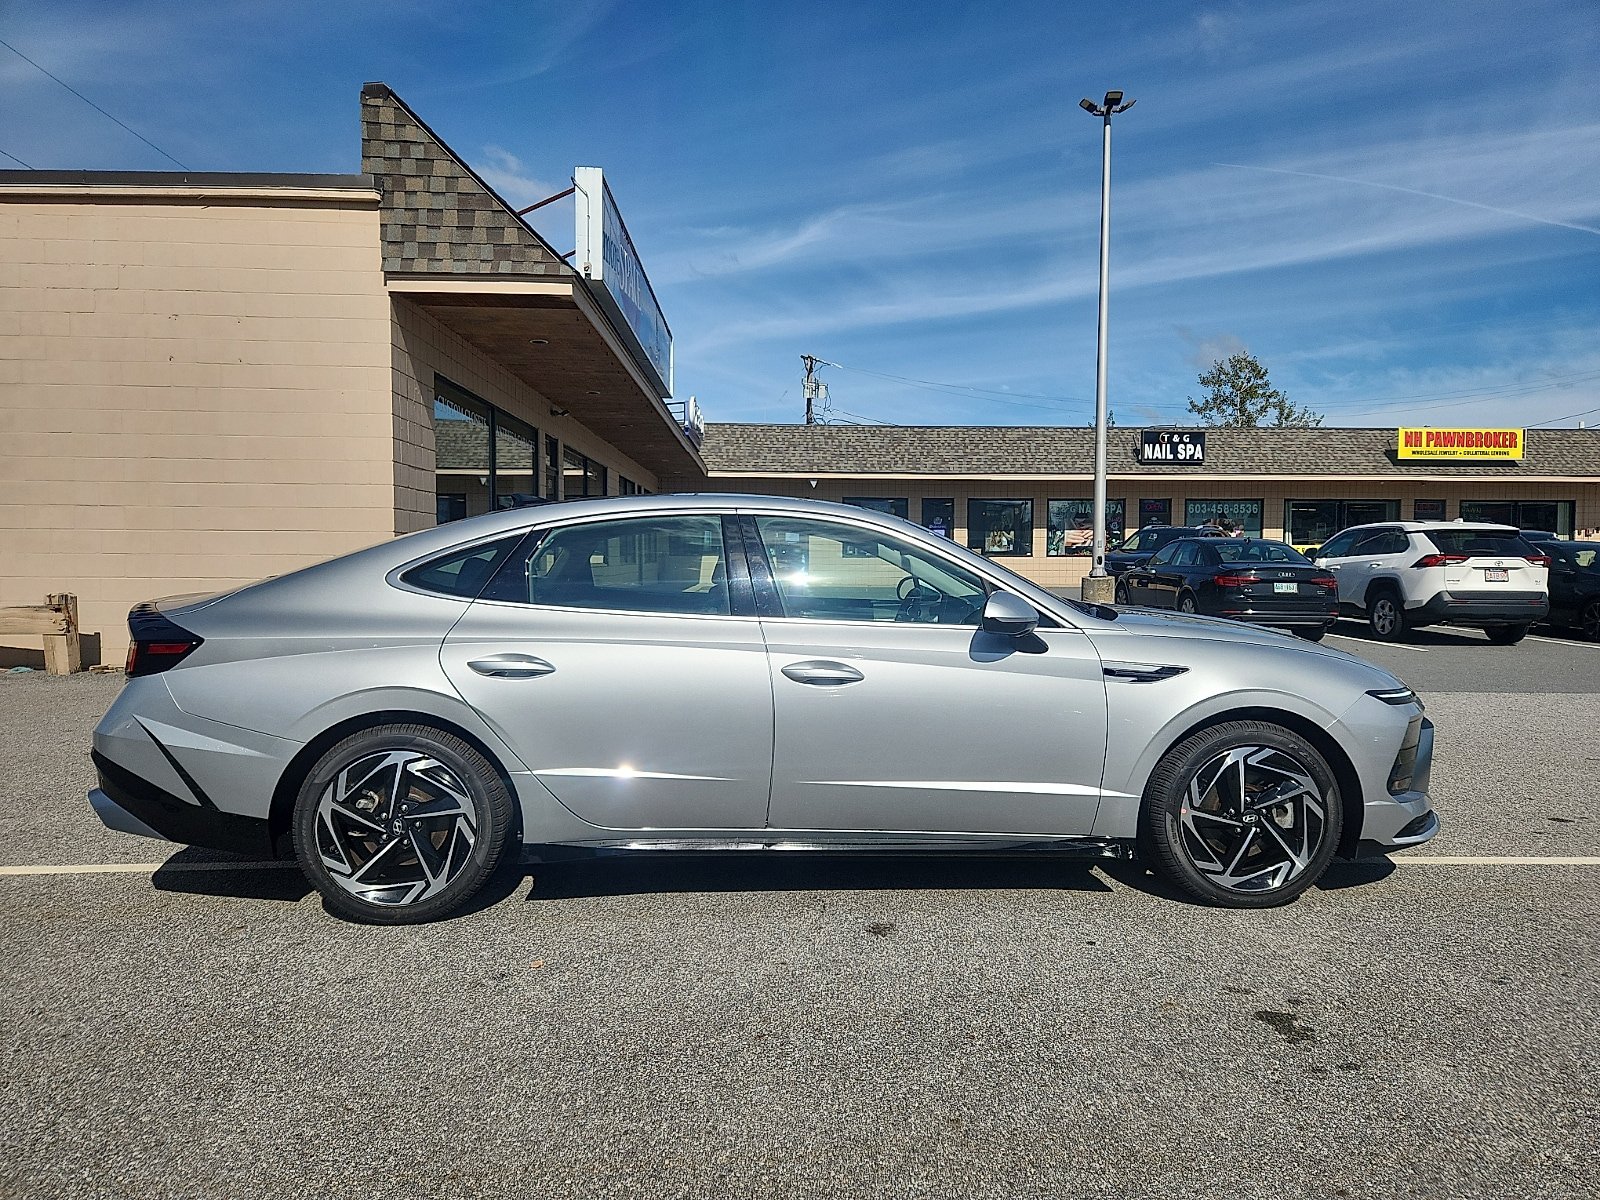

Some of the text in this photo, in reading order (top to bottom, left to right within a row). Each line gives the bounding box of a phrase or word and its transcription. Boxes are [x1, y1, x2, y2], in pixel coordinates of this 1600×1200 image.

[1172, 434, 1180, 442] &
[1183, 434, 1190, 442] G
[1404, 431, 1518, 448] NH PAWNBROKER
[1144, 443, 1203, 460] NAIL SPA
[1105, 503, 1123, 514] SPA
